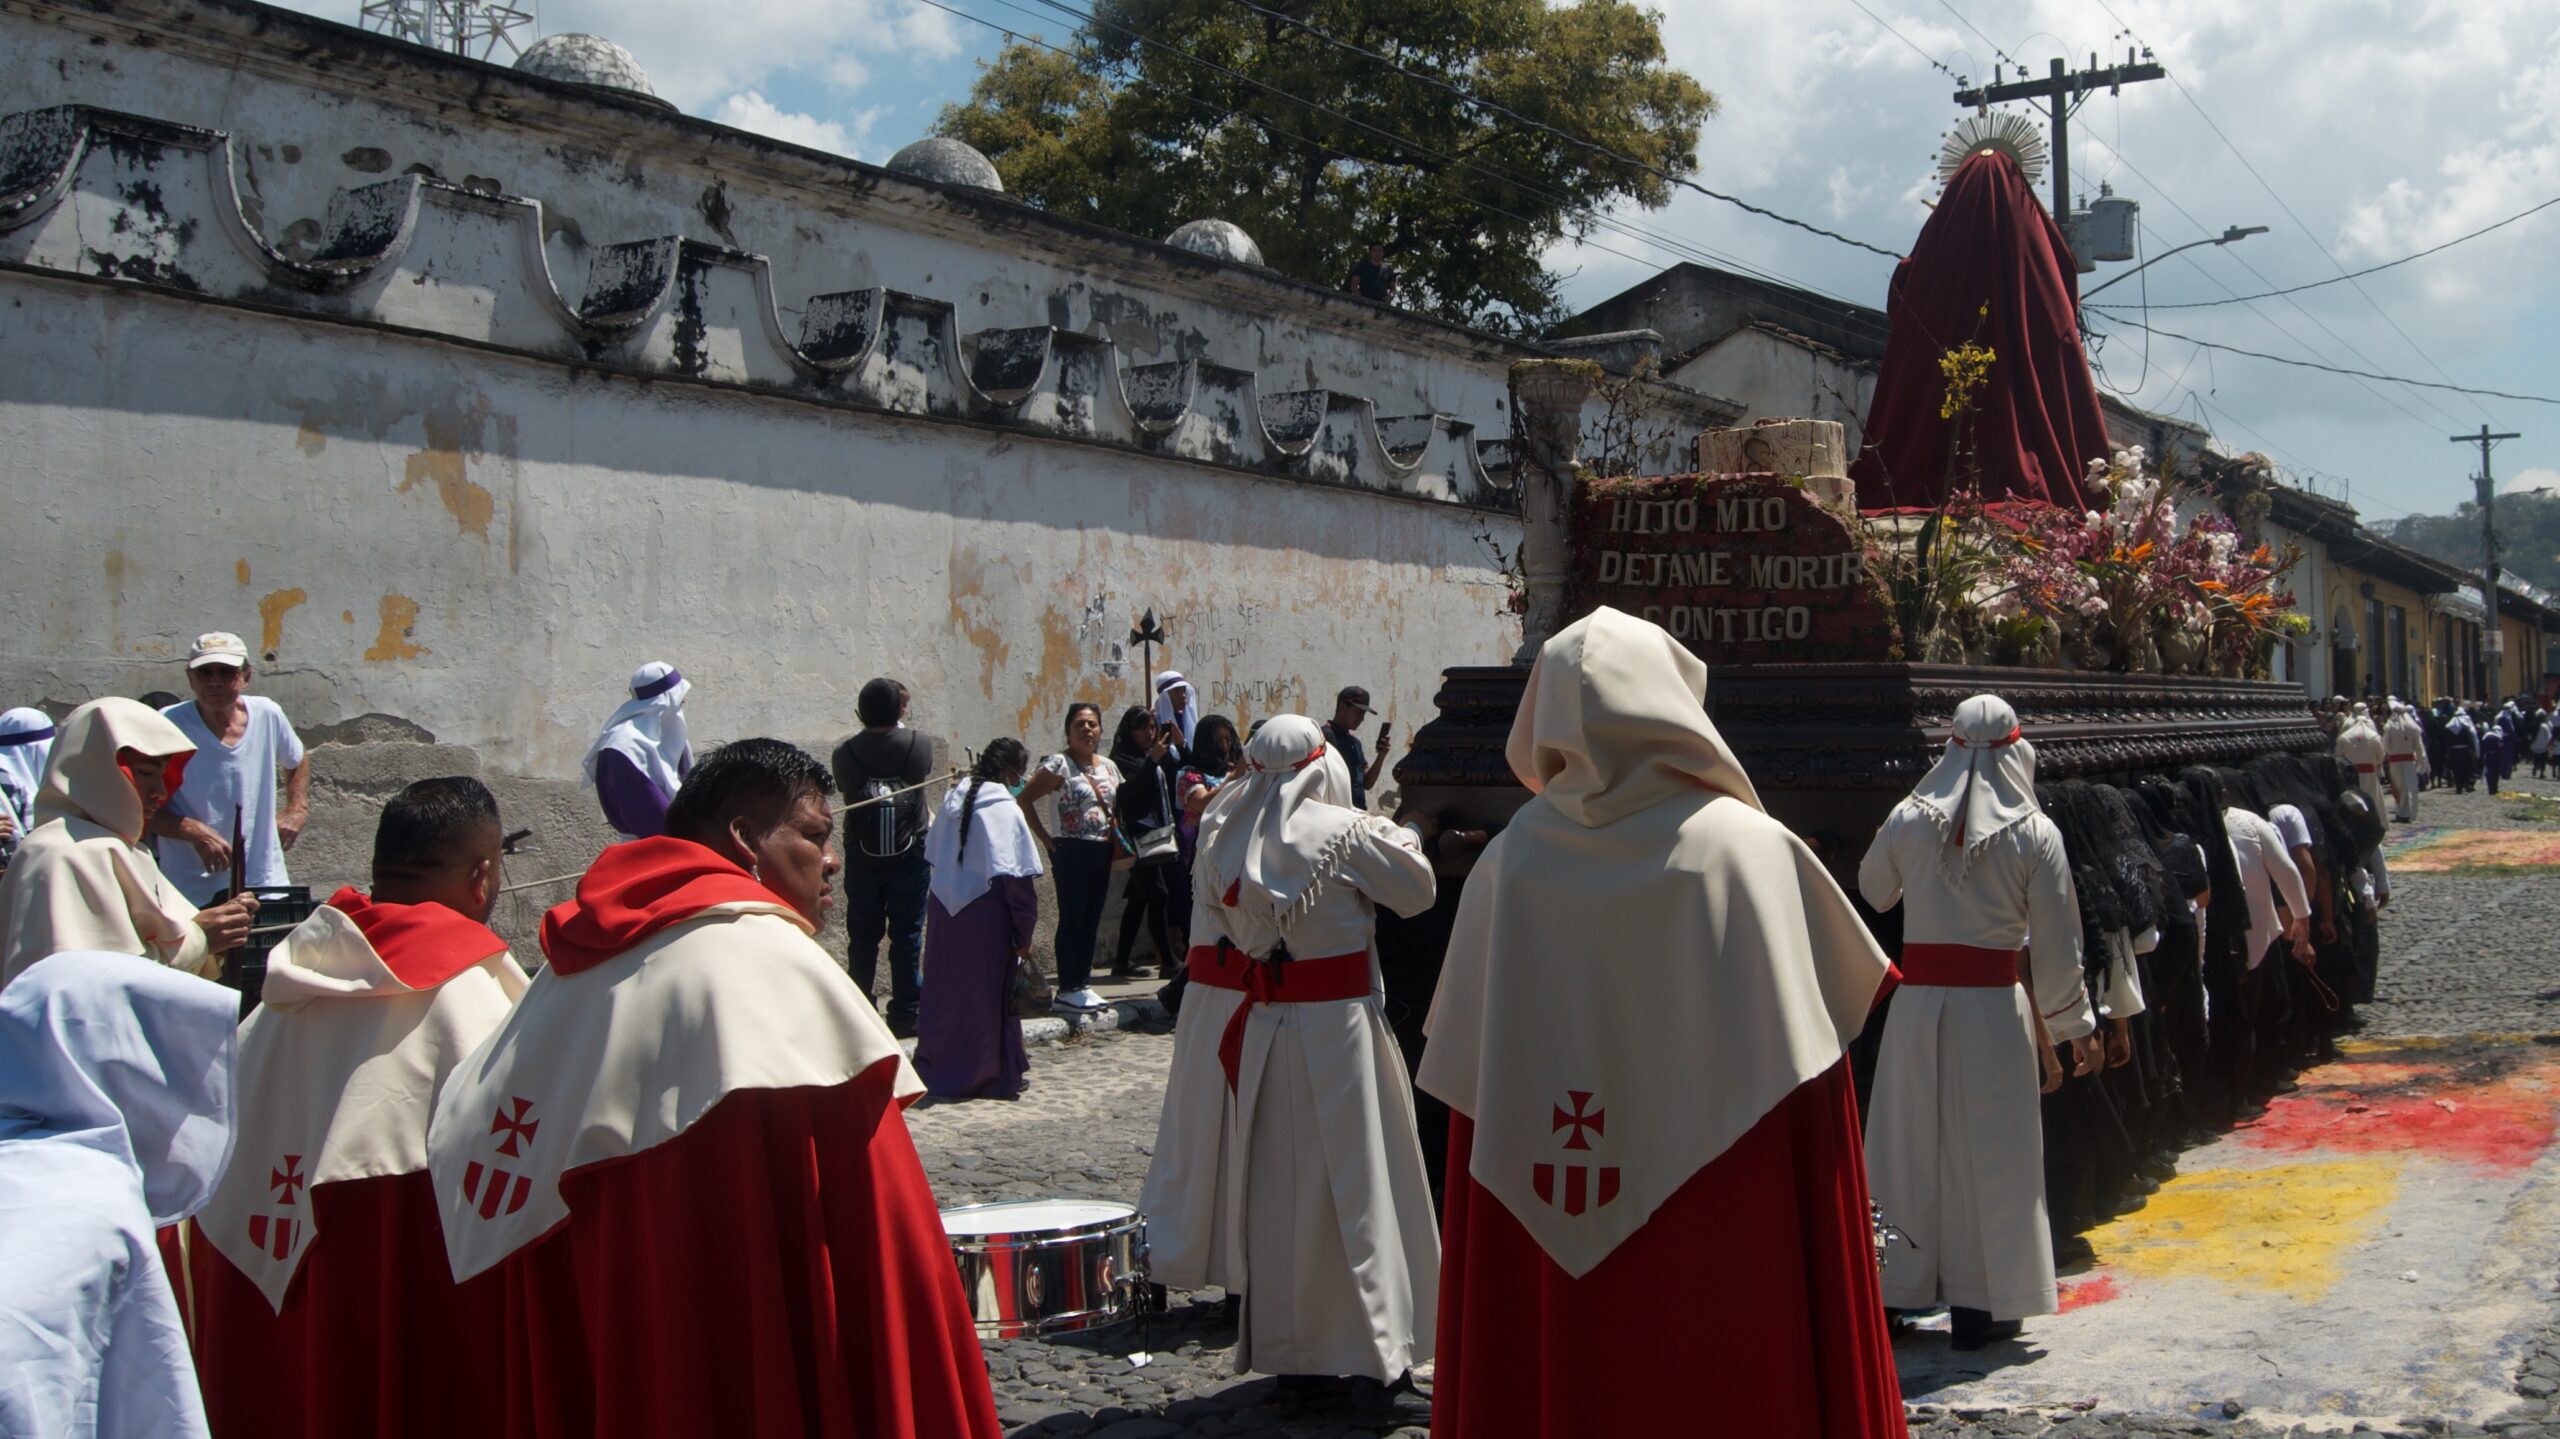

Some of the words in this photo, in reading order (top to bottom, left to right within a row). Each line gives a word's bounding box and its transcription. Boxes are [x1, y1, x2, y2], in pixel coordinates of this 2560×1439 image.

[1609, 497, 1698, 534] HIJO
[1716, 496, 1787, 533] MIO
[1597, 550, 1733, 588] DEJAME
[1750, 551, 1864, 590] MORIR
[1185, 607, 1224, 636] STILL
[1238, 603, 1264, 630] SEE
[1185, 641, 1215, 679] YOU
[1227, 634, 1248, 658] IN
